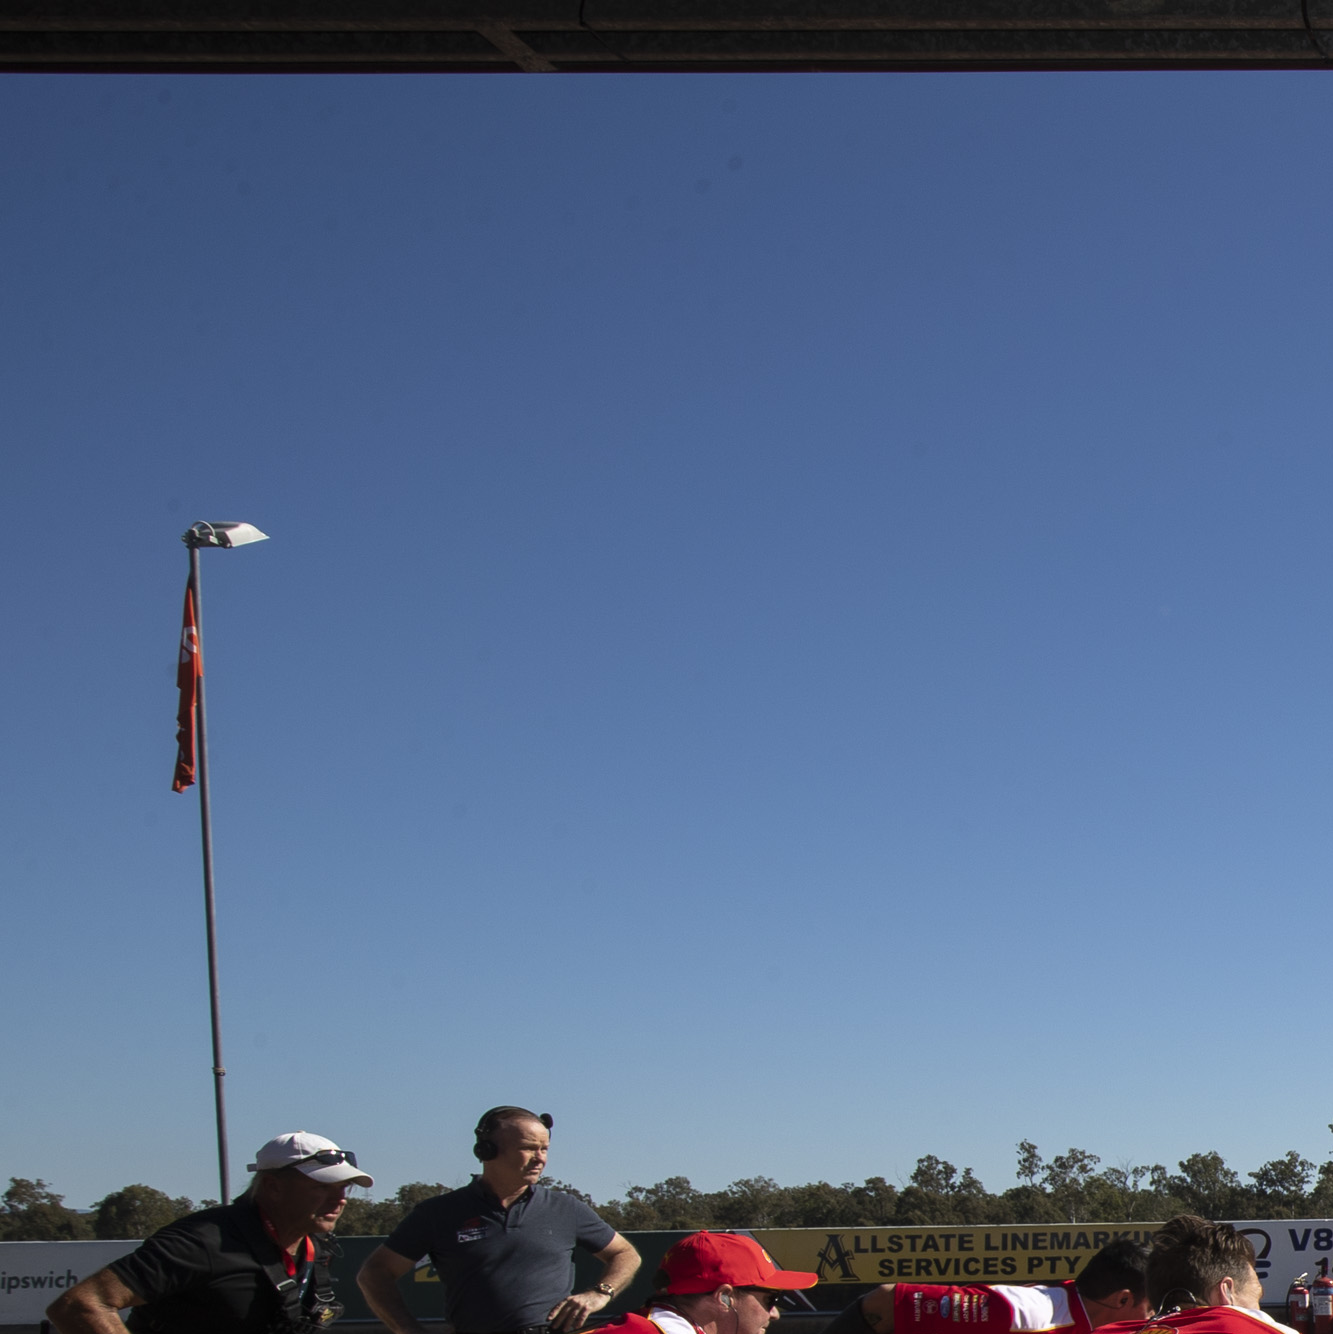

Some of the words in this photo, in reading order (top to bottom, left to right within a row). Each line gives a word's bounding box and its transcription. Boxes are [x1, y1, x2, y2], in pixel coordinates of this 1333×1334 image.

[1288, 1228, 1333, 1251] V8
[816, 1233, 974, 1282] ALLSTATE
[878, 1257, 1017, 1278] SERVICES
[1028, 1256, 1081, 1275] PTY
[1, 1269, 78, 1294] ipswich
